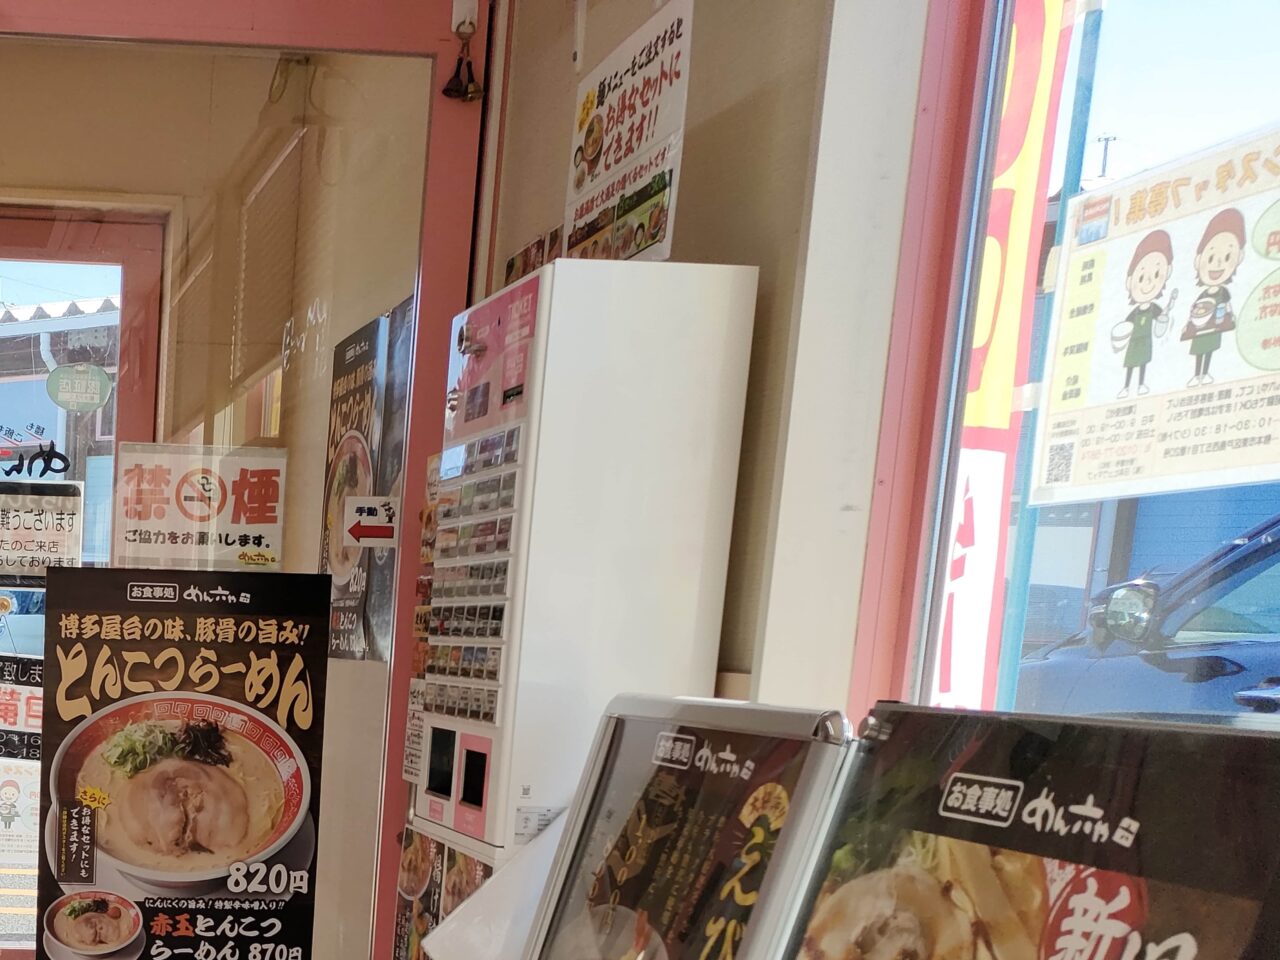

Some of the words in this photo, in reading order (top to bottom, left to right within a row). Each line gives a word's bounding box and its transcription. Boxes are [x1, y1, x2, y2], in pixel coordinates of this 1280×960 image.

[604, 50, 681, 137] お得なセットに
[355, 506, 378, 517] 手動
[124, 529, 271, 549] ご協力をお願いします。
[131, 586, 175, 599] お食事処
[59, 613, 310, 646] 博多屋台の味、豚骨の旨み!!
[55, 641, 313, 731] とんこつらーめん
[79, 789, 107, 805] さらに
[947, 782, 1015, 818] お食事処
[69, 807, 80, 862] できます!
[80, 806, 91, 878] お得なセットにも
[227, 861, 310, 894] 820円
[150, 912, 282, 938] 赤玉とんこつ
